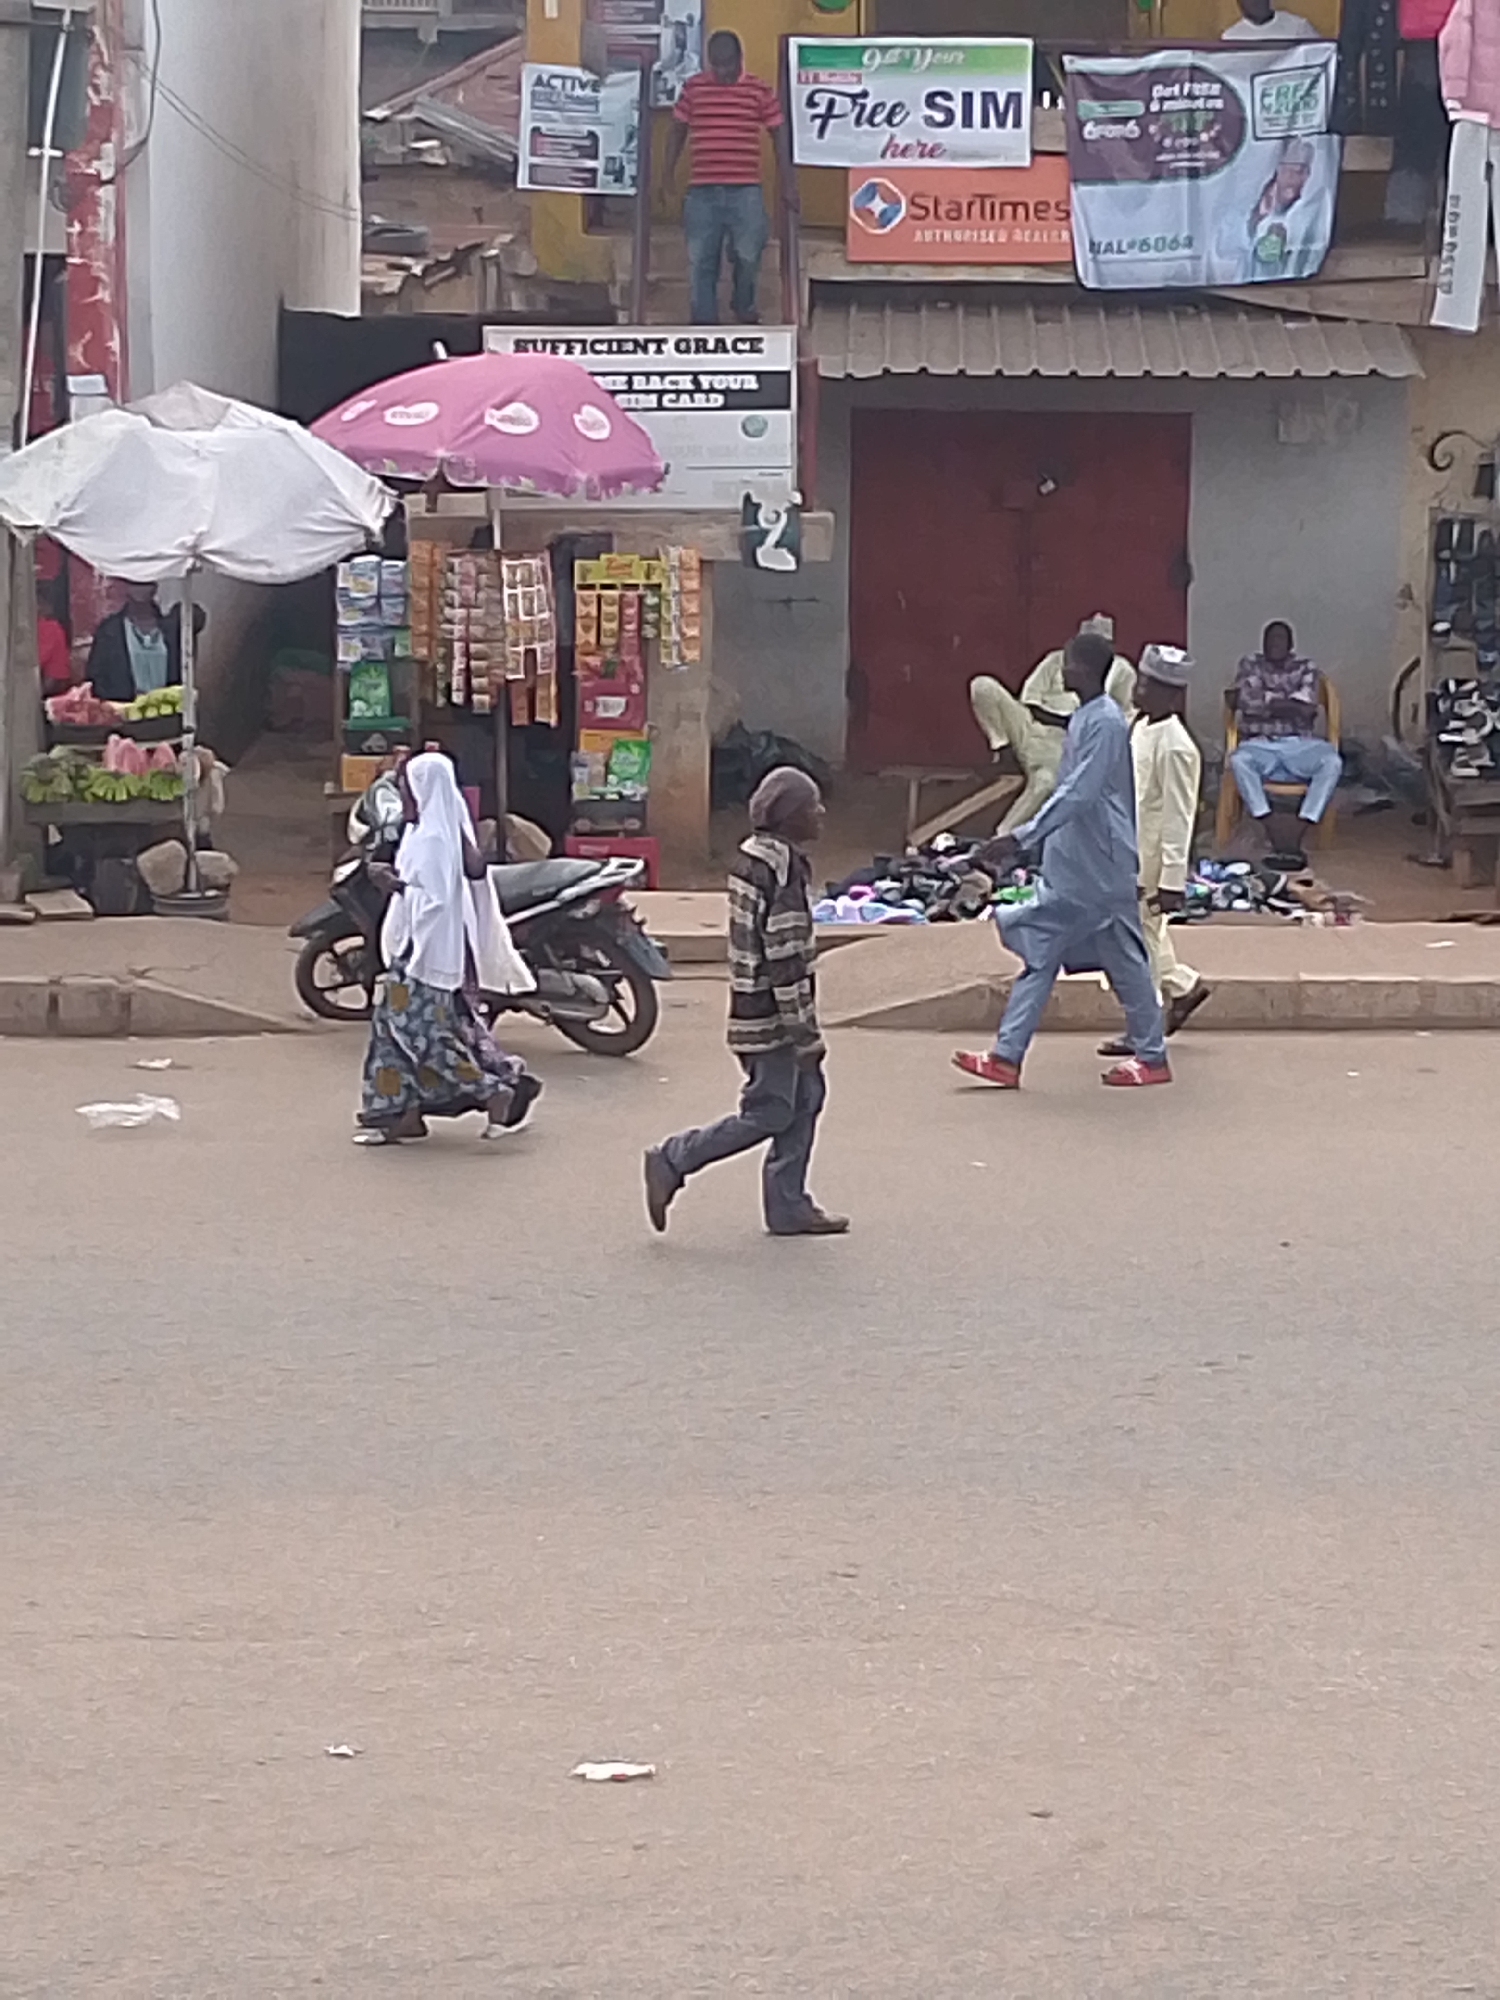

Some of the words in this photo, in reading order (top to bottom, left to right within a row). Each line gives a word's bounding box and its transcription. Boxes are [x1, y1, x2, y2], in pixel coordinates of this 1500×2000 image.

[805, 88, 910, 140] Free
[922, 90, 1023, 130] SIM
[880, 134, 946, 159] here
[908, 194, 1070, 222] StarTimes
[513, 338, 669, 355] SUFFICIENT
[673, 337, 764, 355] GRACE
[632, 375, 695, 391] BACK
[698, 374, 759, 390] YOUR
[661, 393, 725, 408] CARD
